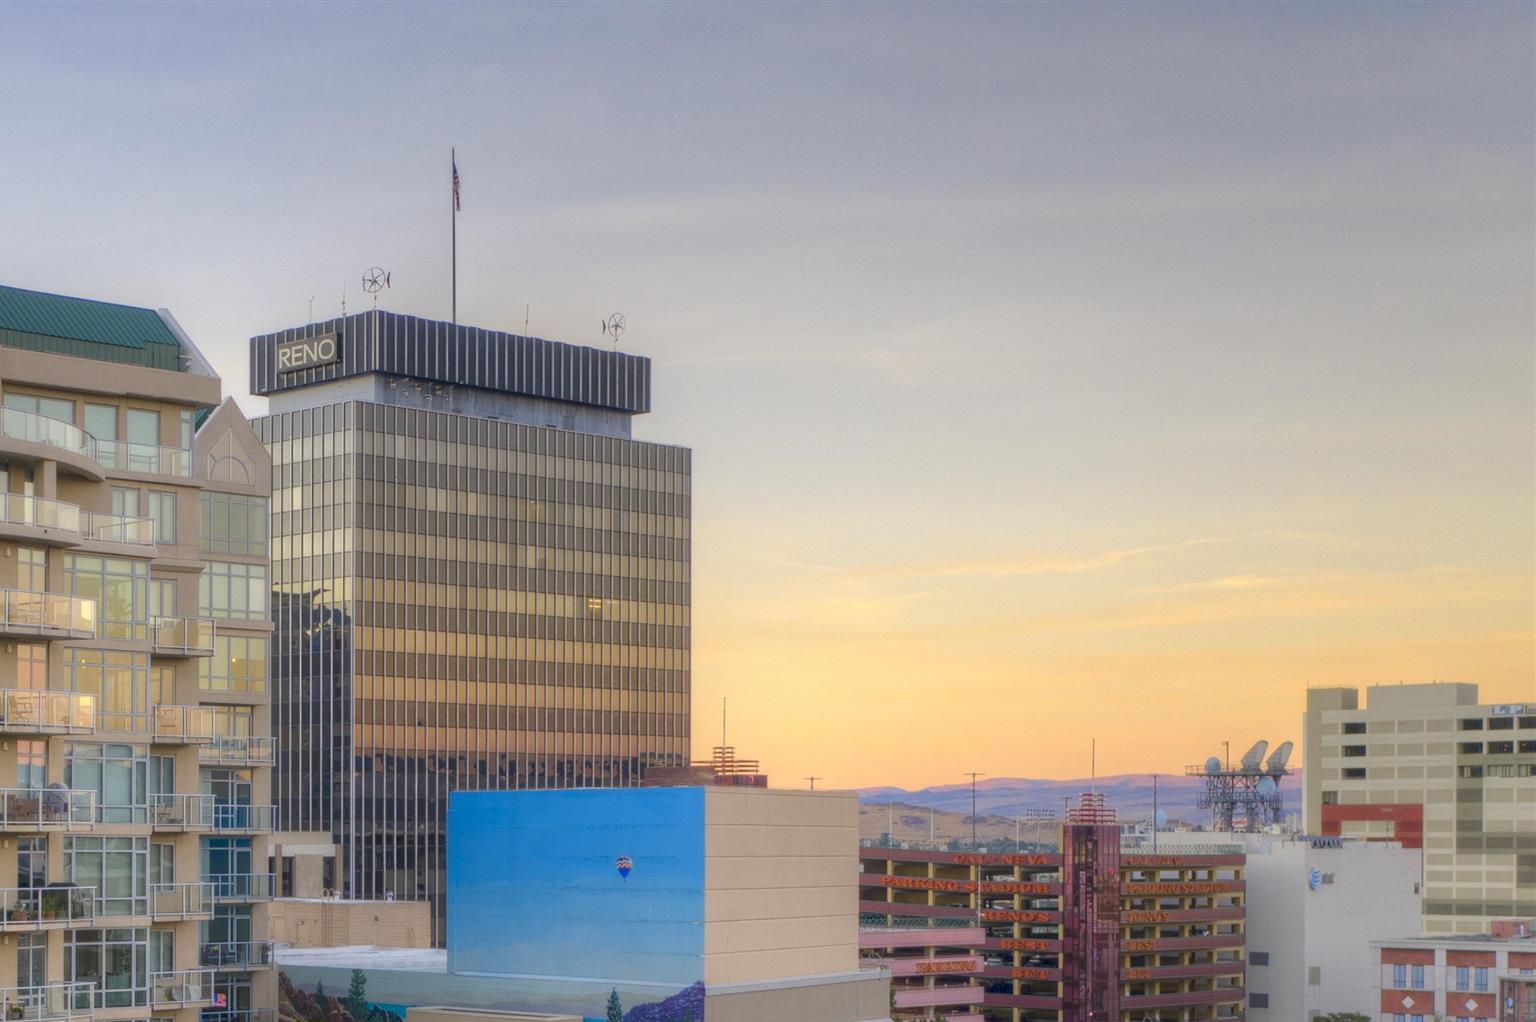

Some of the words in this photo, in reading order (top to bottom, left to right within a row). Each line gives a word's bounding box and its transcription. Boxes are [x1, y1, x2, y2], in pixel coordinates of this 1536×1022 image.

[279, 339, 335, 368] RENO
[1001, 855, 1049, 865] NEVA
[880, 875, 960, 890] PARKING
[1001, 940, 1048, 949] BEST
[1012, 968, 1048, 978] BET
